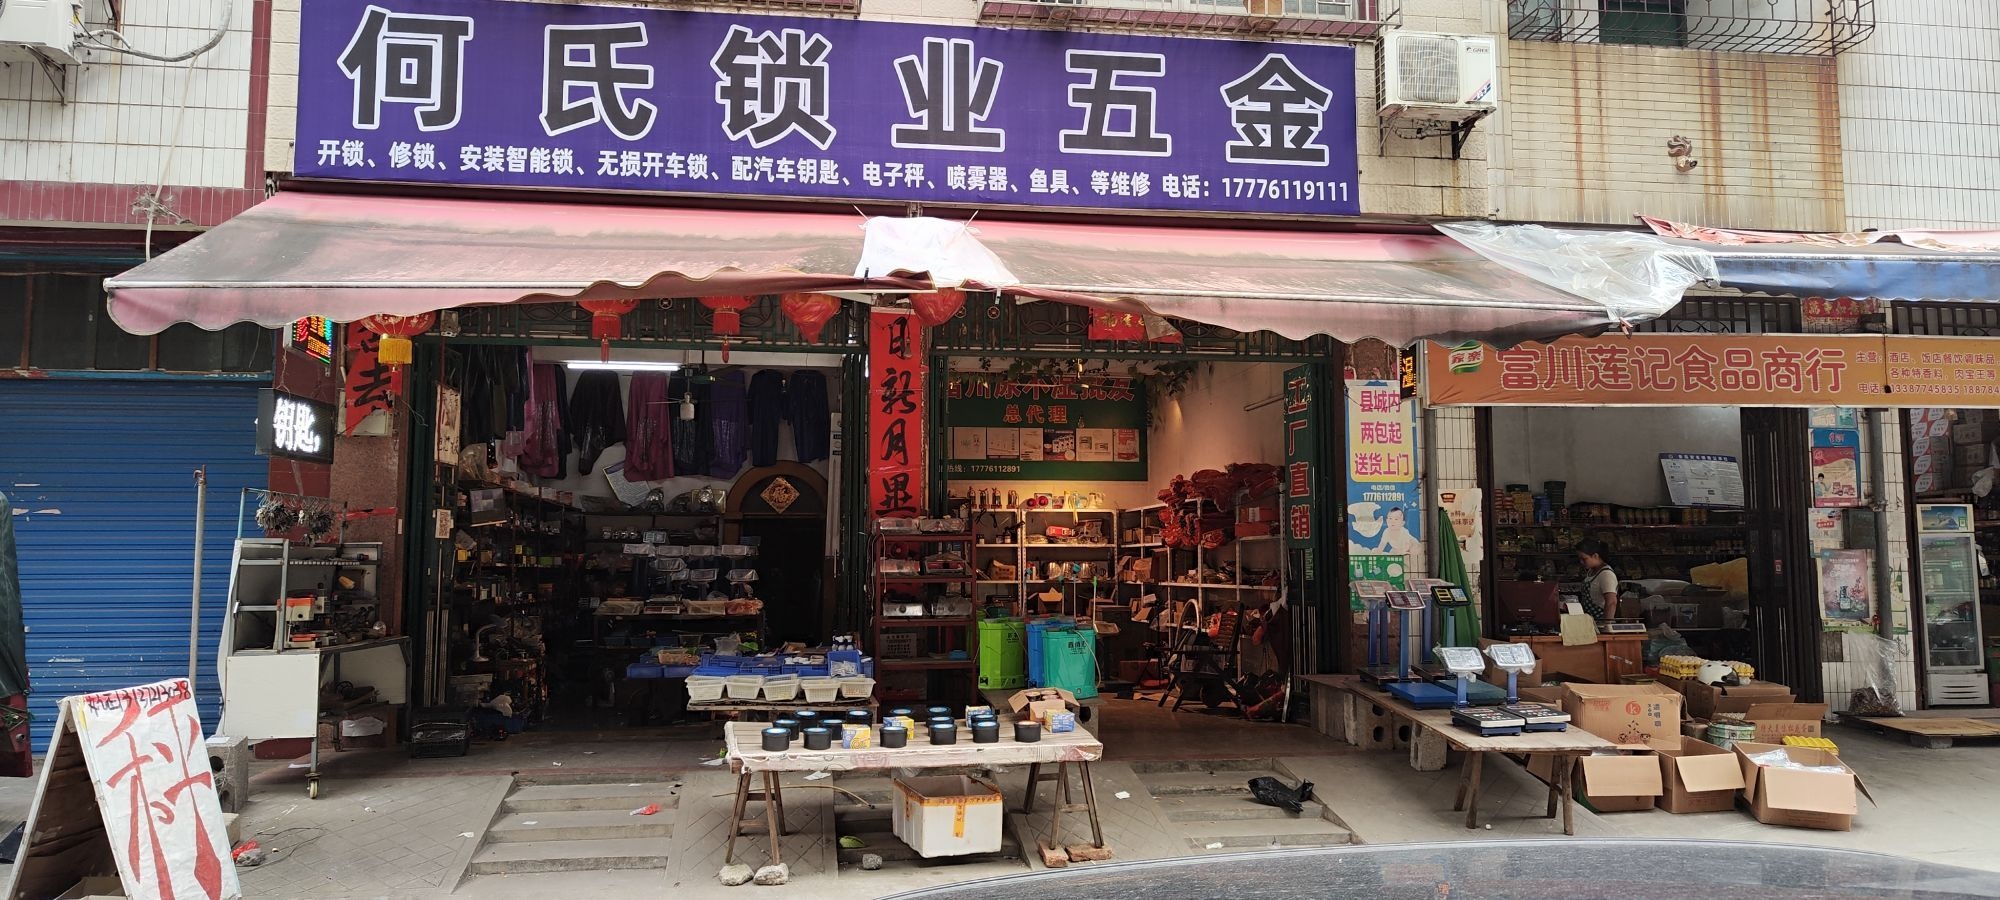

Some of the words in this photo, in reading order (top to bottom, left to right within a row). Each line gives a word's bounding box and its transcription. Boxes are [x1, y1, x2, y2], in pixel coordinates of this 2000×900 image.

[337, 5, 1333, 166] 何氏锁业五金
[317, 138, 1150, 197] 开锁、修锁、安装智能锁、无损开车锁、配汽车钥匙、电子秤、喷雾器、鱼具、等维修
[1162, 173, 1349, 202] 电话：17776119111
[1495, 344, 1846, 393] 富川莲记食品商行
[1003, 404, 1068, 424] 总代理
[1359, 389, 1401, 414] 县城内
[1360, 421, 1403, 445] 两包起
[1288, 376, 1311, 540] 工厂直销
[1354, 453, 1410, 477] 送货上门
[1362, 492, 1405, 502] 17776112891
